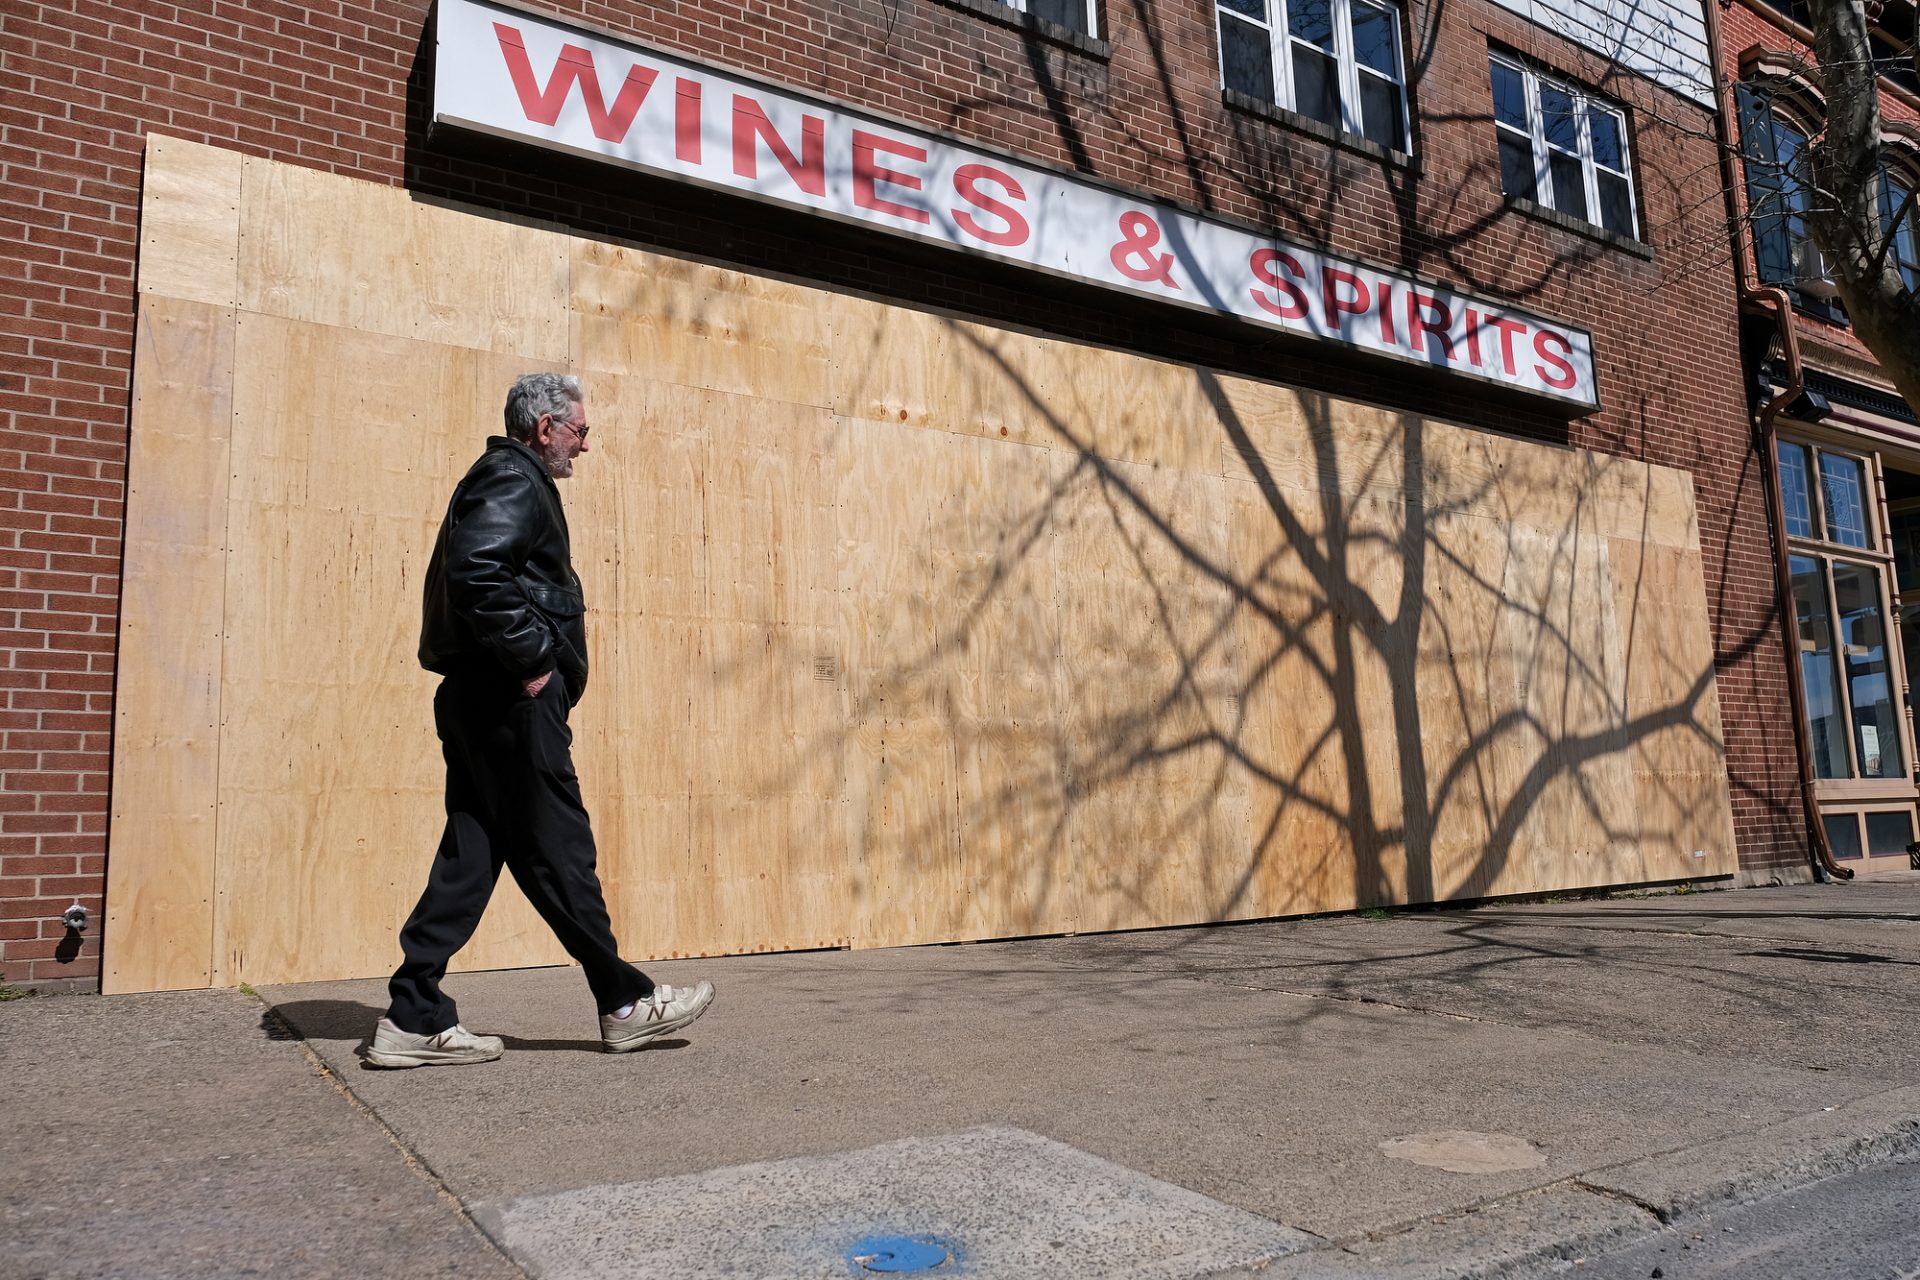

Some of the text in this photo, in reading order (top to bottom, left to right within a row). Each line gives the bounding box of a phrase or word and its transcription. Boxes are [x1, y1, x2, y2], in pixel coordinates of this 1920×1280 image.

[493, 21, 1577, 390] WINES & SPIRITS
[646, 1004, 666, 1021] N
